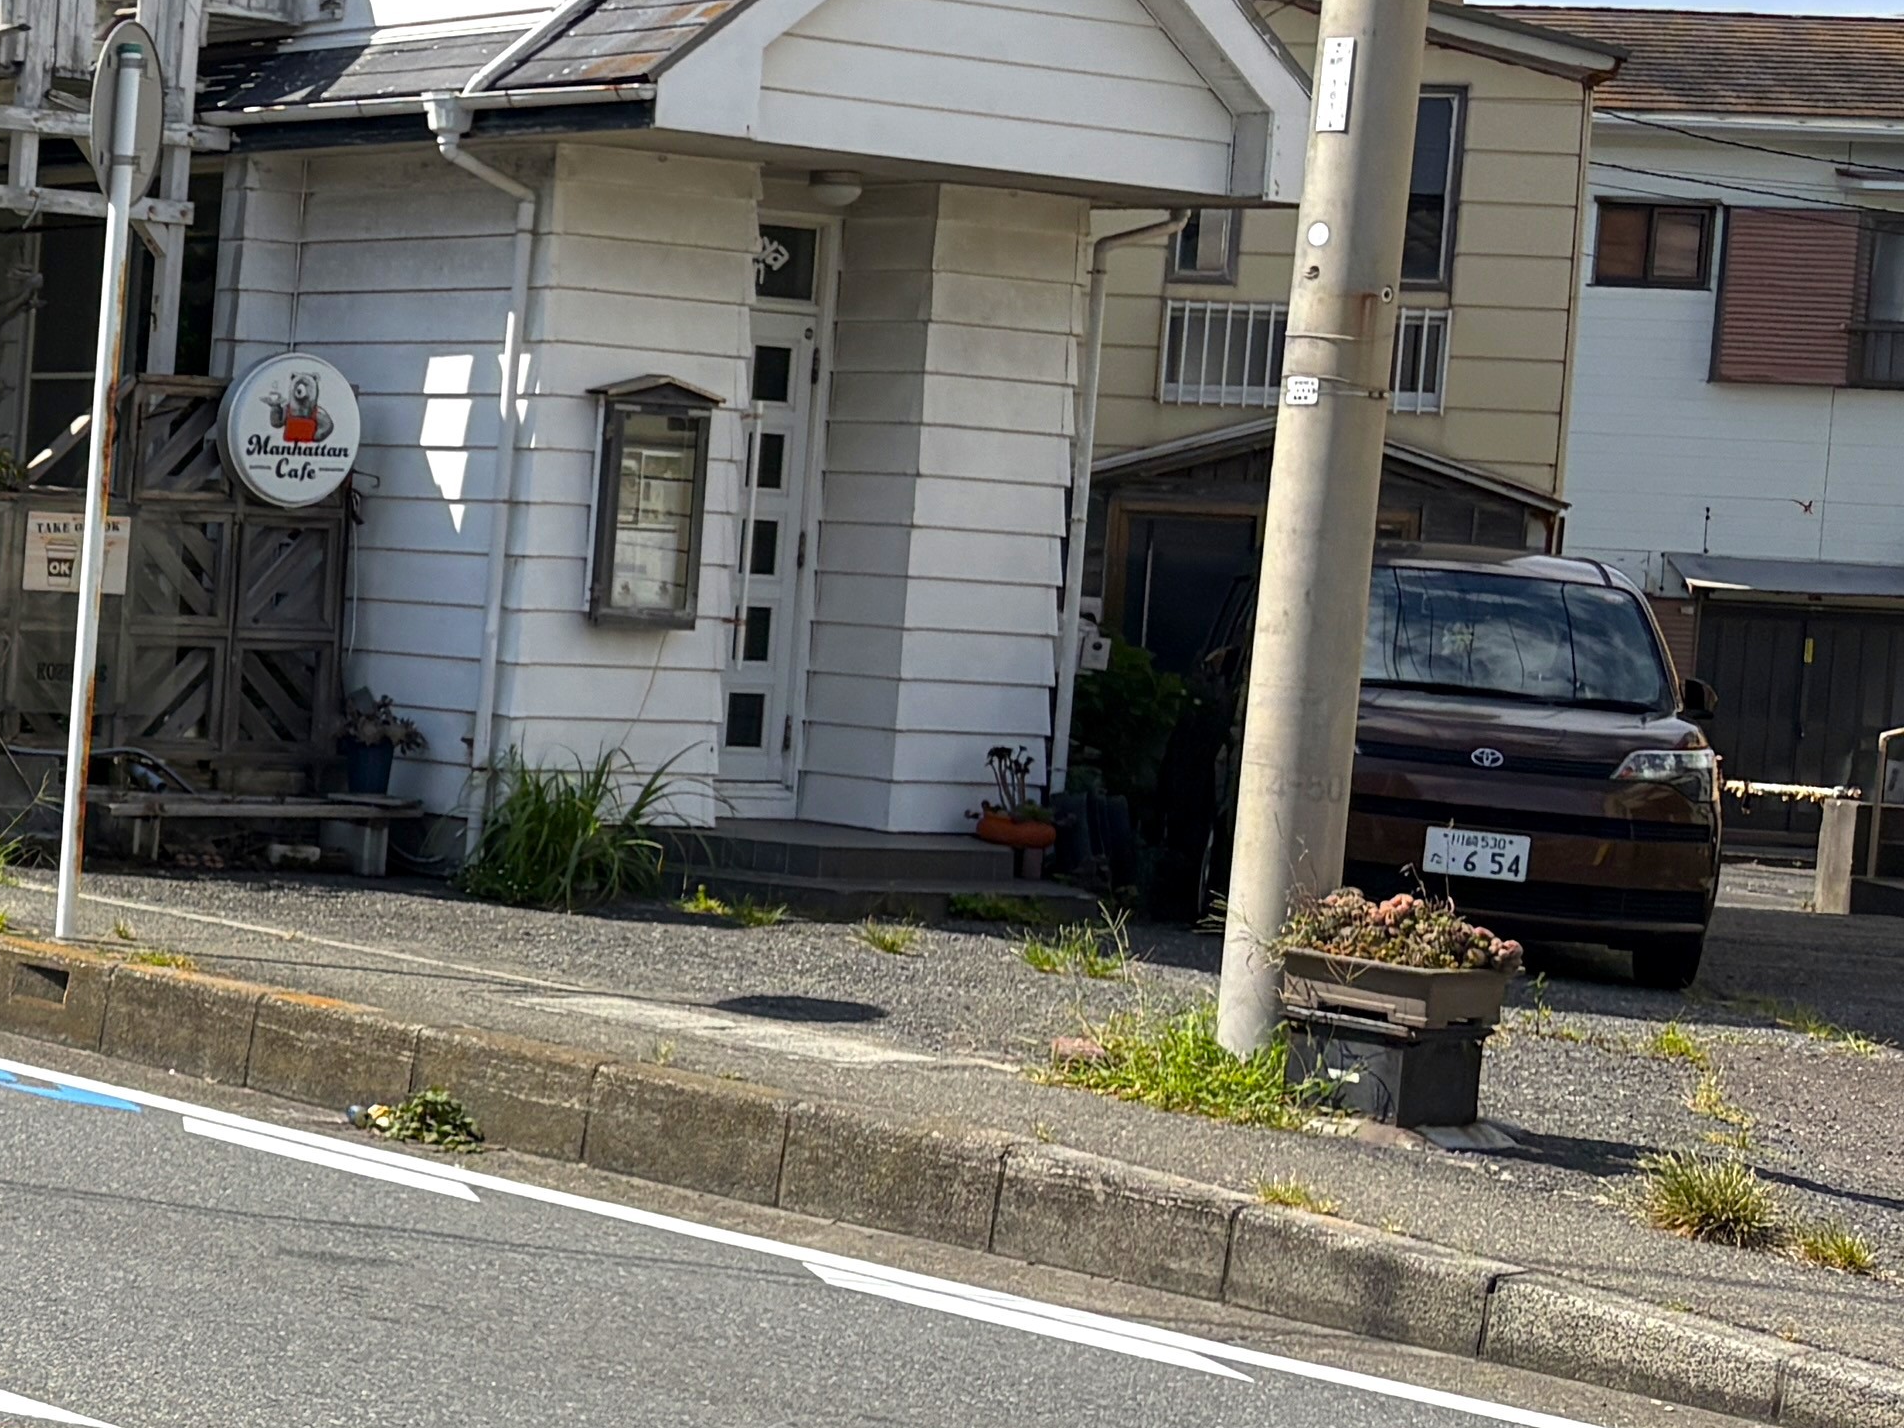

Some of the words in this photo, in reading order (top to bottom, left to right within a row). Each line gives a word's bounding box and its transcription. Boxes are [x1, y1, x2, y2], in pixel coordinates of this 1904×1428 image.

[245, 433, 350, 458] Manhattan
[274, 457, 317, 482] Cafe
[36, 522, 71, 533] TAKE
[49, 562, 71, 575] OK
